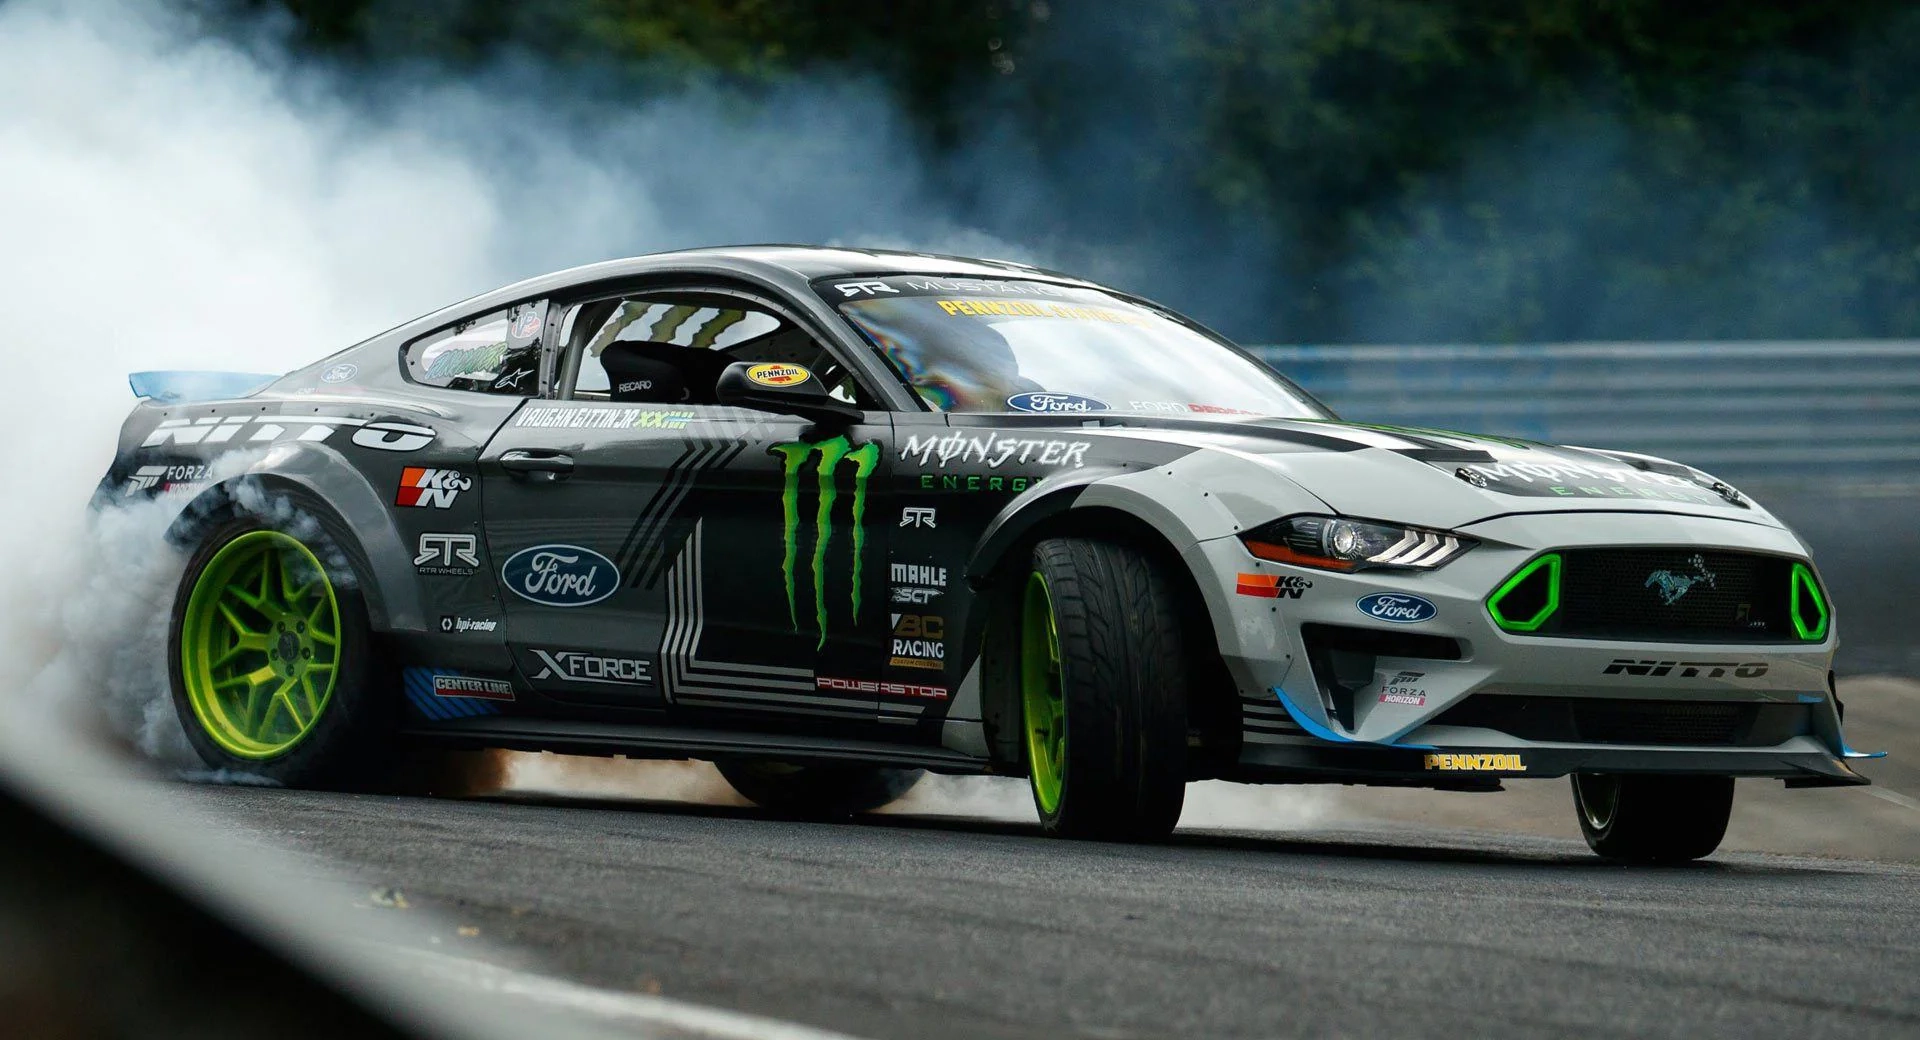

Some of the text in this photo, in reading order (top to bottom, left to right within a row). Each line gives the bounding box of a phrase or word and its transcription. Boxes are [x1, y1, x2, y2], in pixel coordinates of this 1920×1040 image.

[906, 281, 1064, 297] MUSTANG
[936, 300, 1054, 317] PENNZOIL
[756, 368, 799, 379] PENNZOIL
[618, 379, 652, 393] RECARO
[140, 415, 436, 451] NITTO
[166, 466, 213, 480] FORZA
[899, 507, 936, 529] RTR
[413, 533, 480, 567] RTR
[524, 552, 598, 597] Ford
[891, 563, 947, 587] MAHLE
[1371, 596, 1421, 620] Ford
[455, 617, 497, 632] hpi-racing
[892, 639, 945, 659] RACING
[1602, 659, 1769, 678] NITTO
[435, 678, 511, 695] CENTER LINE
[1381, 686, 1426, 696] FORZA
[1384, 694, 1421, 705] HORIZON
[1424, 754, 1527, 771] PENNZOIL
